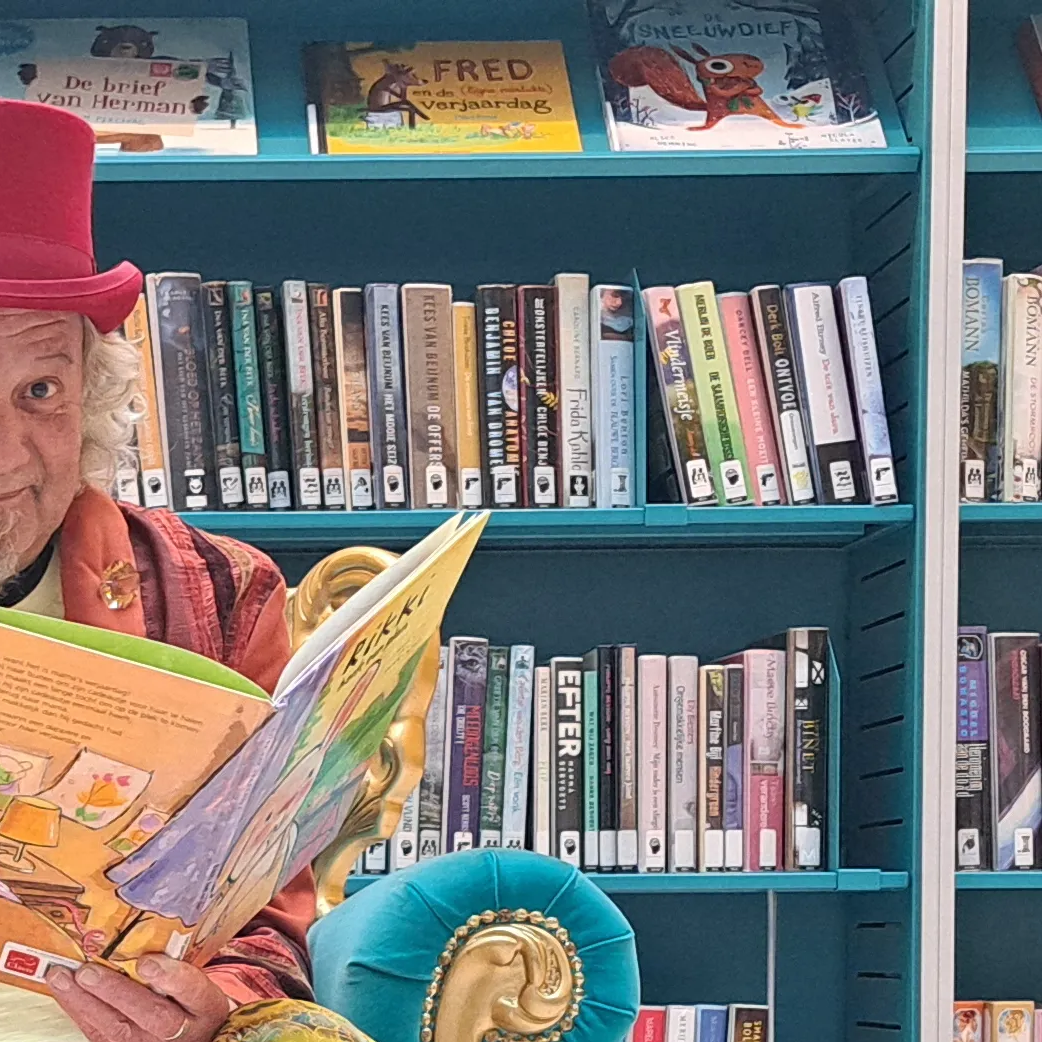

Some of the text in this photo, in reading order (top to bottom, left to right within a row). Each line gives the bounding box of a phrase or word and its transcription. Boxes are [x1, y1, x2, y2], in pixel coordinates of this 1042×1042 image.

[638, 20, 795, 41] SNEEUWDIEF
[432, 58, 535, 83] FRED
[64, 75, 168, 98] De brief
[412, 87, 456, 98] en de
[92, 93, 188, 116] Herman
[420, 97, 554, 115] verjaardag
[379, 304, 391, 327] KEES
[423, 295, 437, 323] KEES
[766, 304, 780, 330] Derk
[965, 277, 981, 352] BOMANN
[381, 330, 393, 348] VAN
[424, 327, 436, 348] VAN
[484, 307, 502, 375] BENJAMIN
[502, 320, 516, 362] CHLOE
[812, 292, 831, 372] Alfred De
[1024, 296, 1039, 368] BOMANN
[382, 350, 395, 390] BEIJNUM
[742, 349, 752, 372] BELL
[425, 352, 439, 400] BEIJNUM
[663, 329, 694, 421] Vlindermeisje
[709, 371, 720, 382] DE
[427, 405, 441, 421] DE
[487, 391, 504, 416] VAN
[566, 388, 588, 427] Frida
[620, 375, 630, 456] Lori Benton
[385, 413, 397, 443] MOOIE
[387, 444, 399, 466] SEIZ
[765, 658, 777, 699] Maeve
[557, 670, 582, 757] EFTER
[801, 718, 821, 774] BINET
[759, 779, 770, 828] verandere
